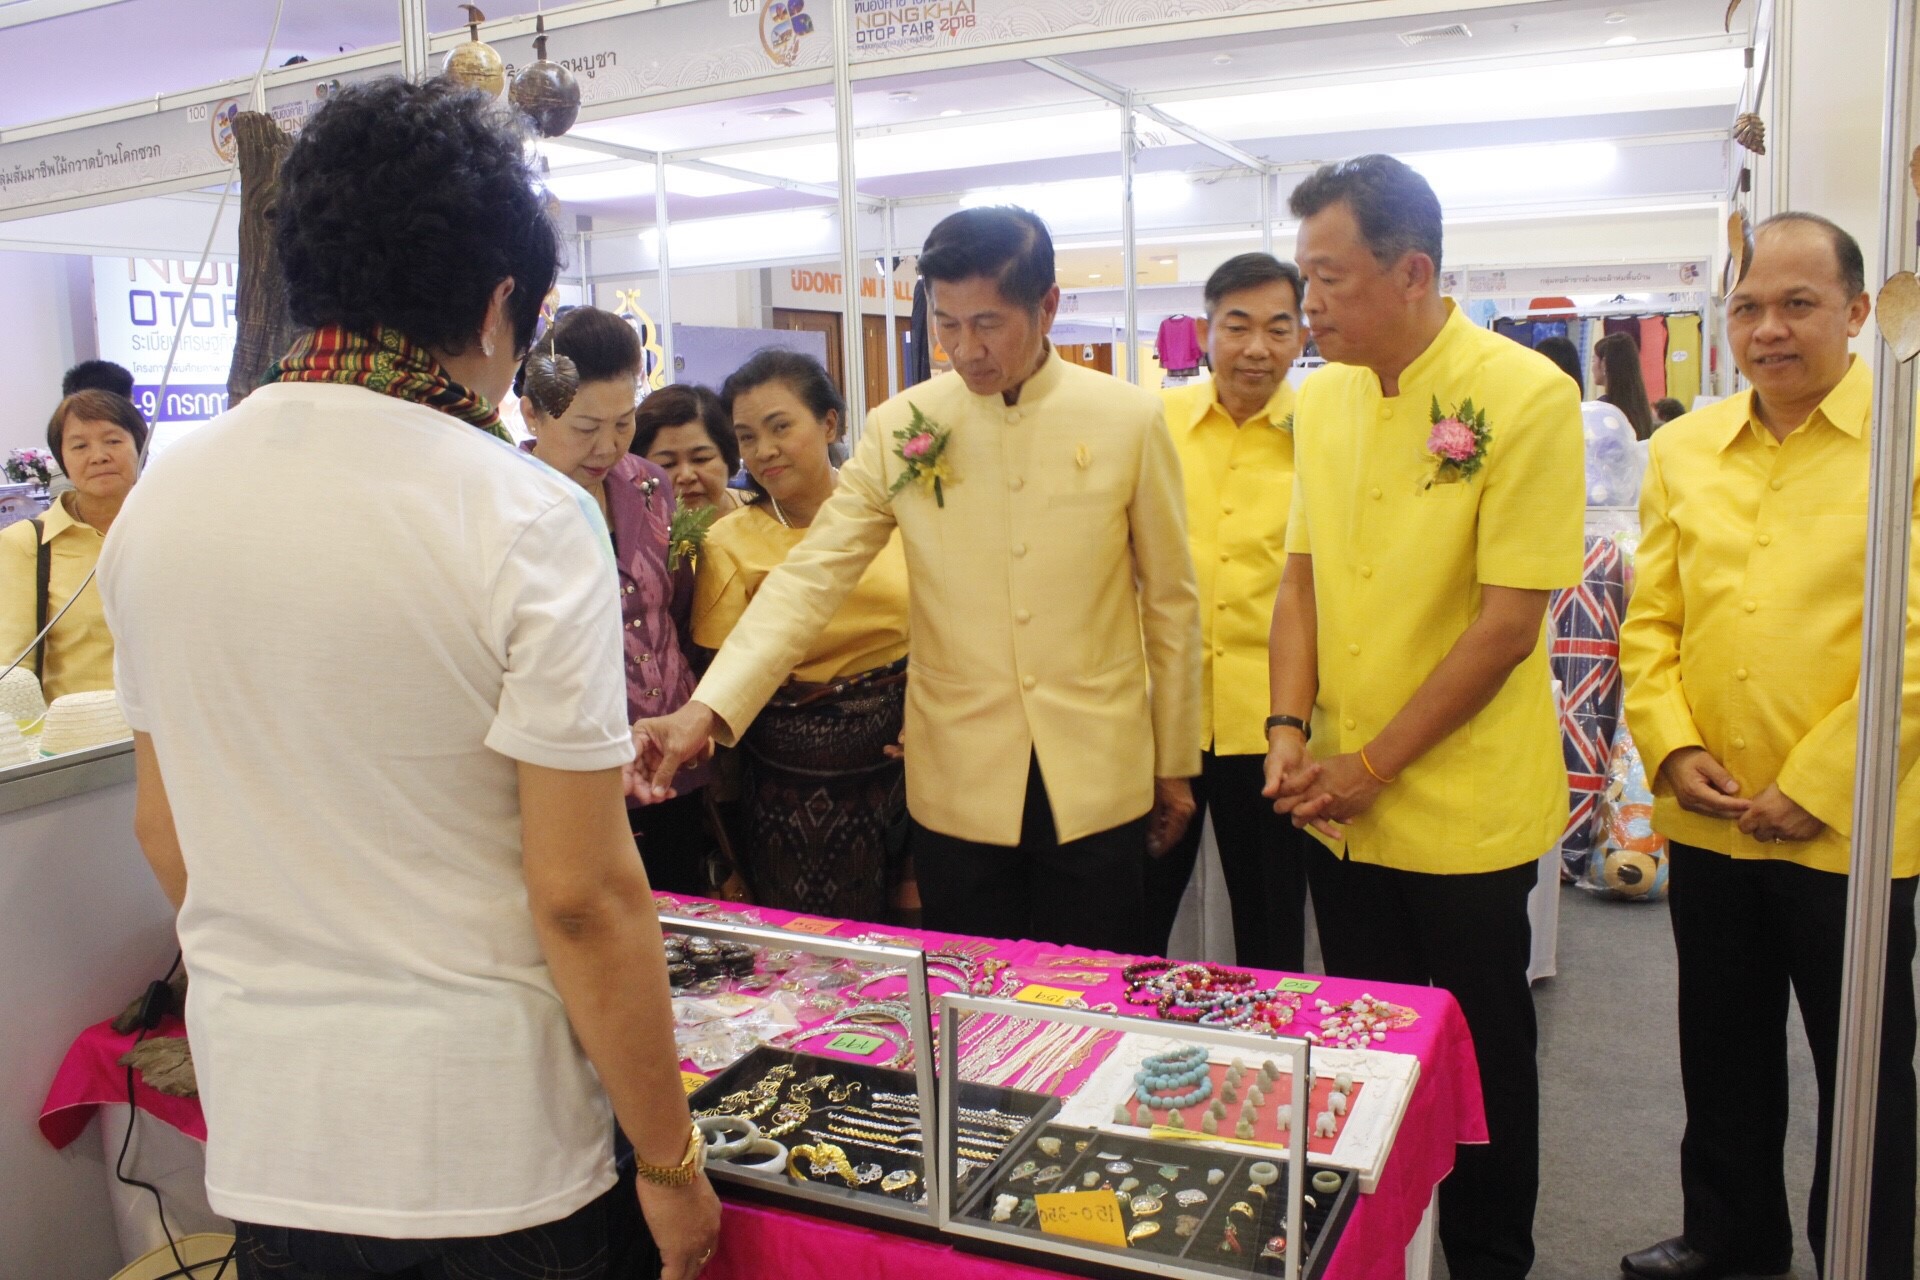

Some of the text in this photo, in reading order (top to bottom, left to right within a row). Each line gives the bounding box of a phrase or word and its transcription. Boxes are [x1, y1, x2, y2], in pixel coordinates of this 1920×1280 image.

[856, 0, 976, 30] NONG KHAI
[856, 26, 896, 43] OTOP
[901, 20, 934, 37] FAIR
[940, 15, 976, 32] 2018
[189, 106, 206, 120] 100
[791, 268, 877, 298] UDONTNI
